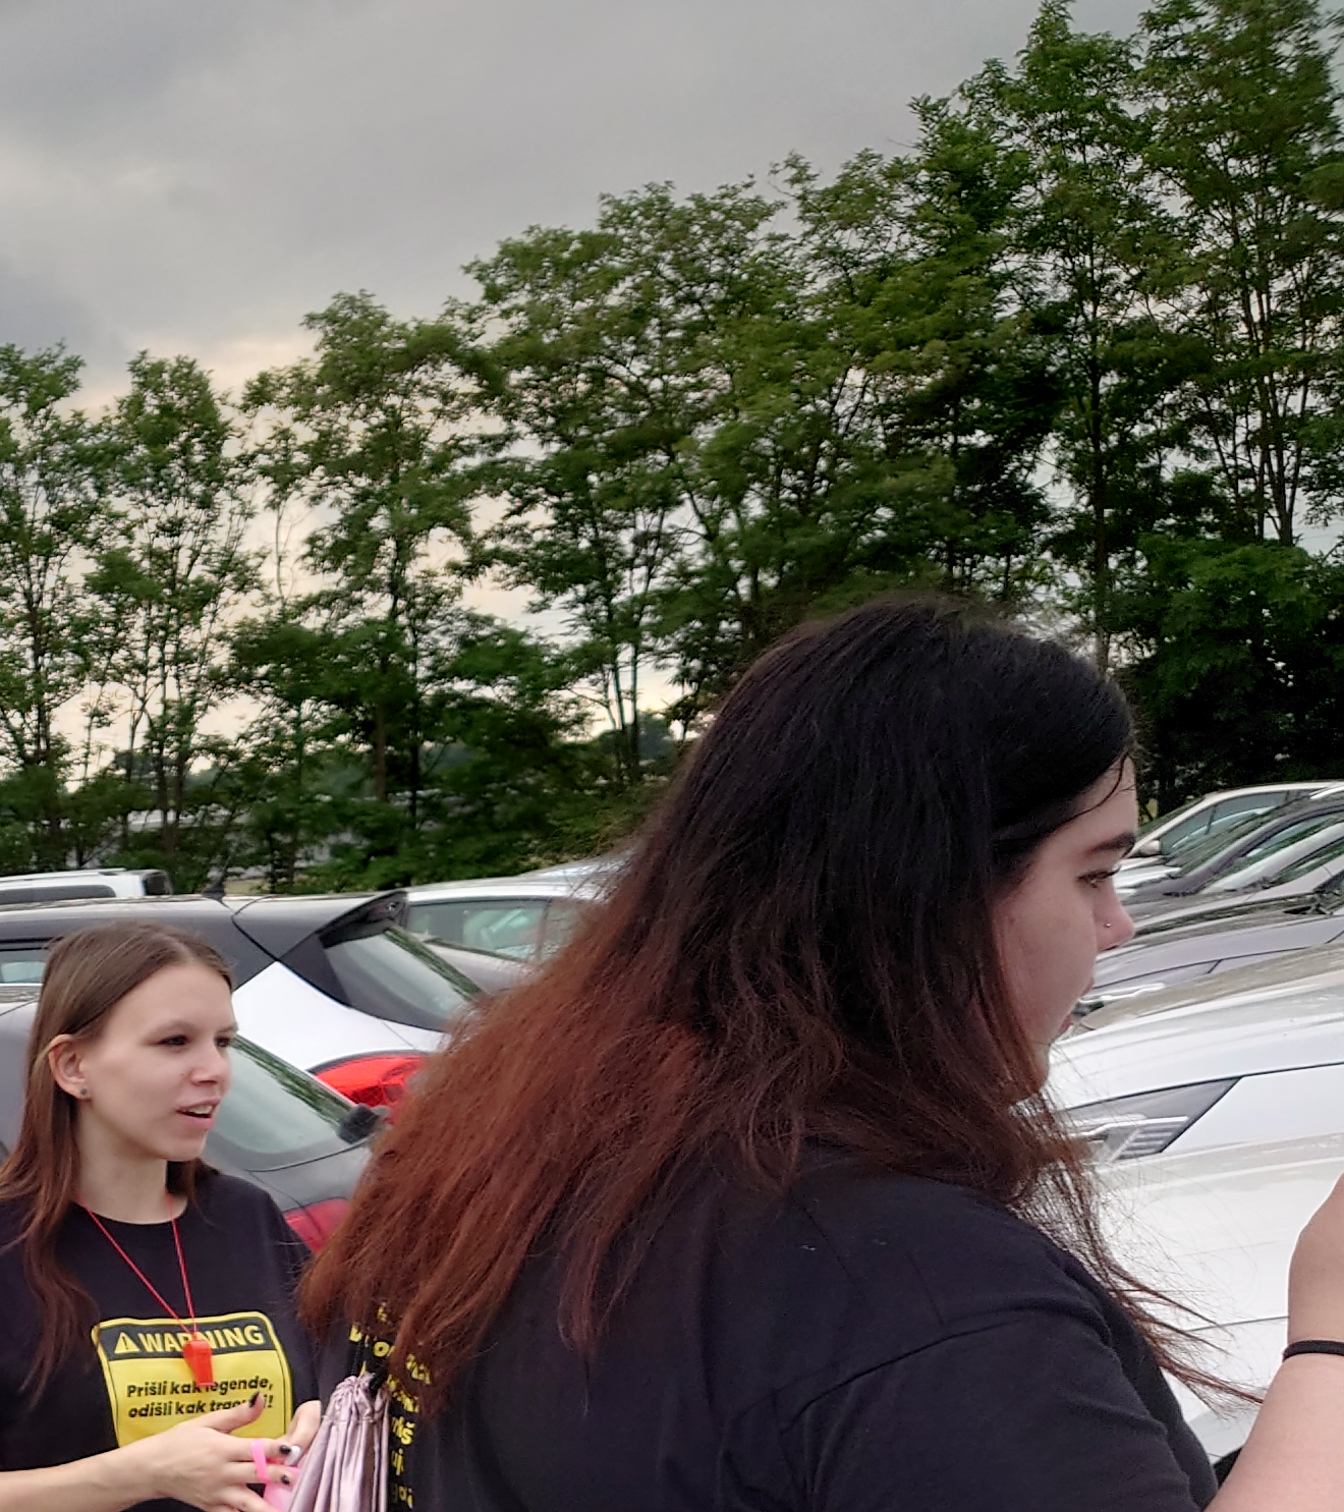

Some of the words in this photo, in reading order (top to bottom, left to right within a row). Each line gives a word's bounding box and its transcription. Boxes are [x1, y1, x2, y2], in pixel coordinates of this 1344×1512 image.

[126, 1381, 168, 1397] Prišli
[128, 1401, 173, 1418] odišli
[175, 1400, 206, 1414] kak
